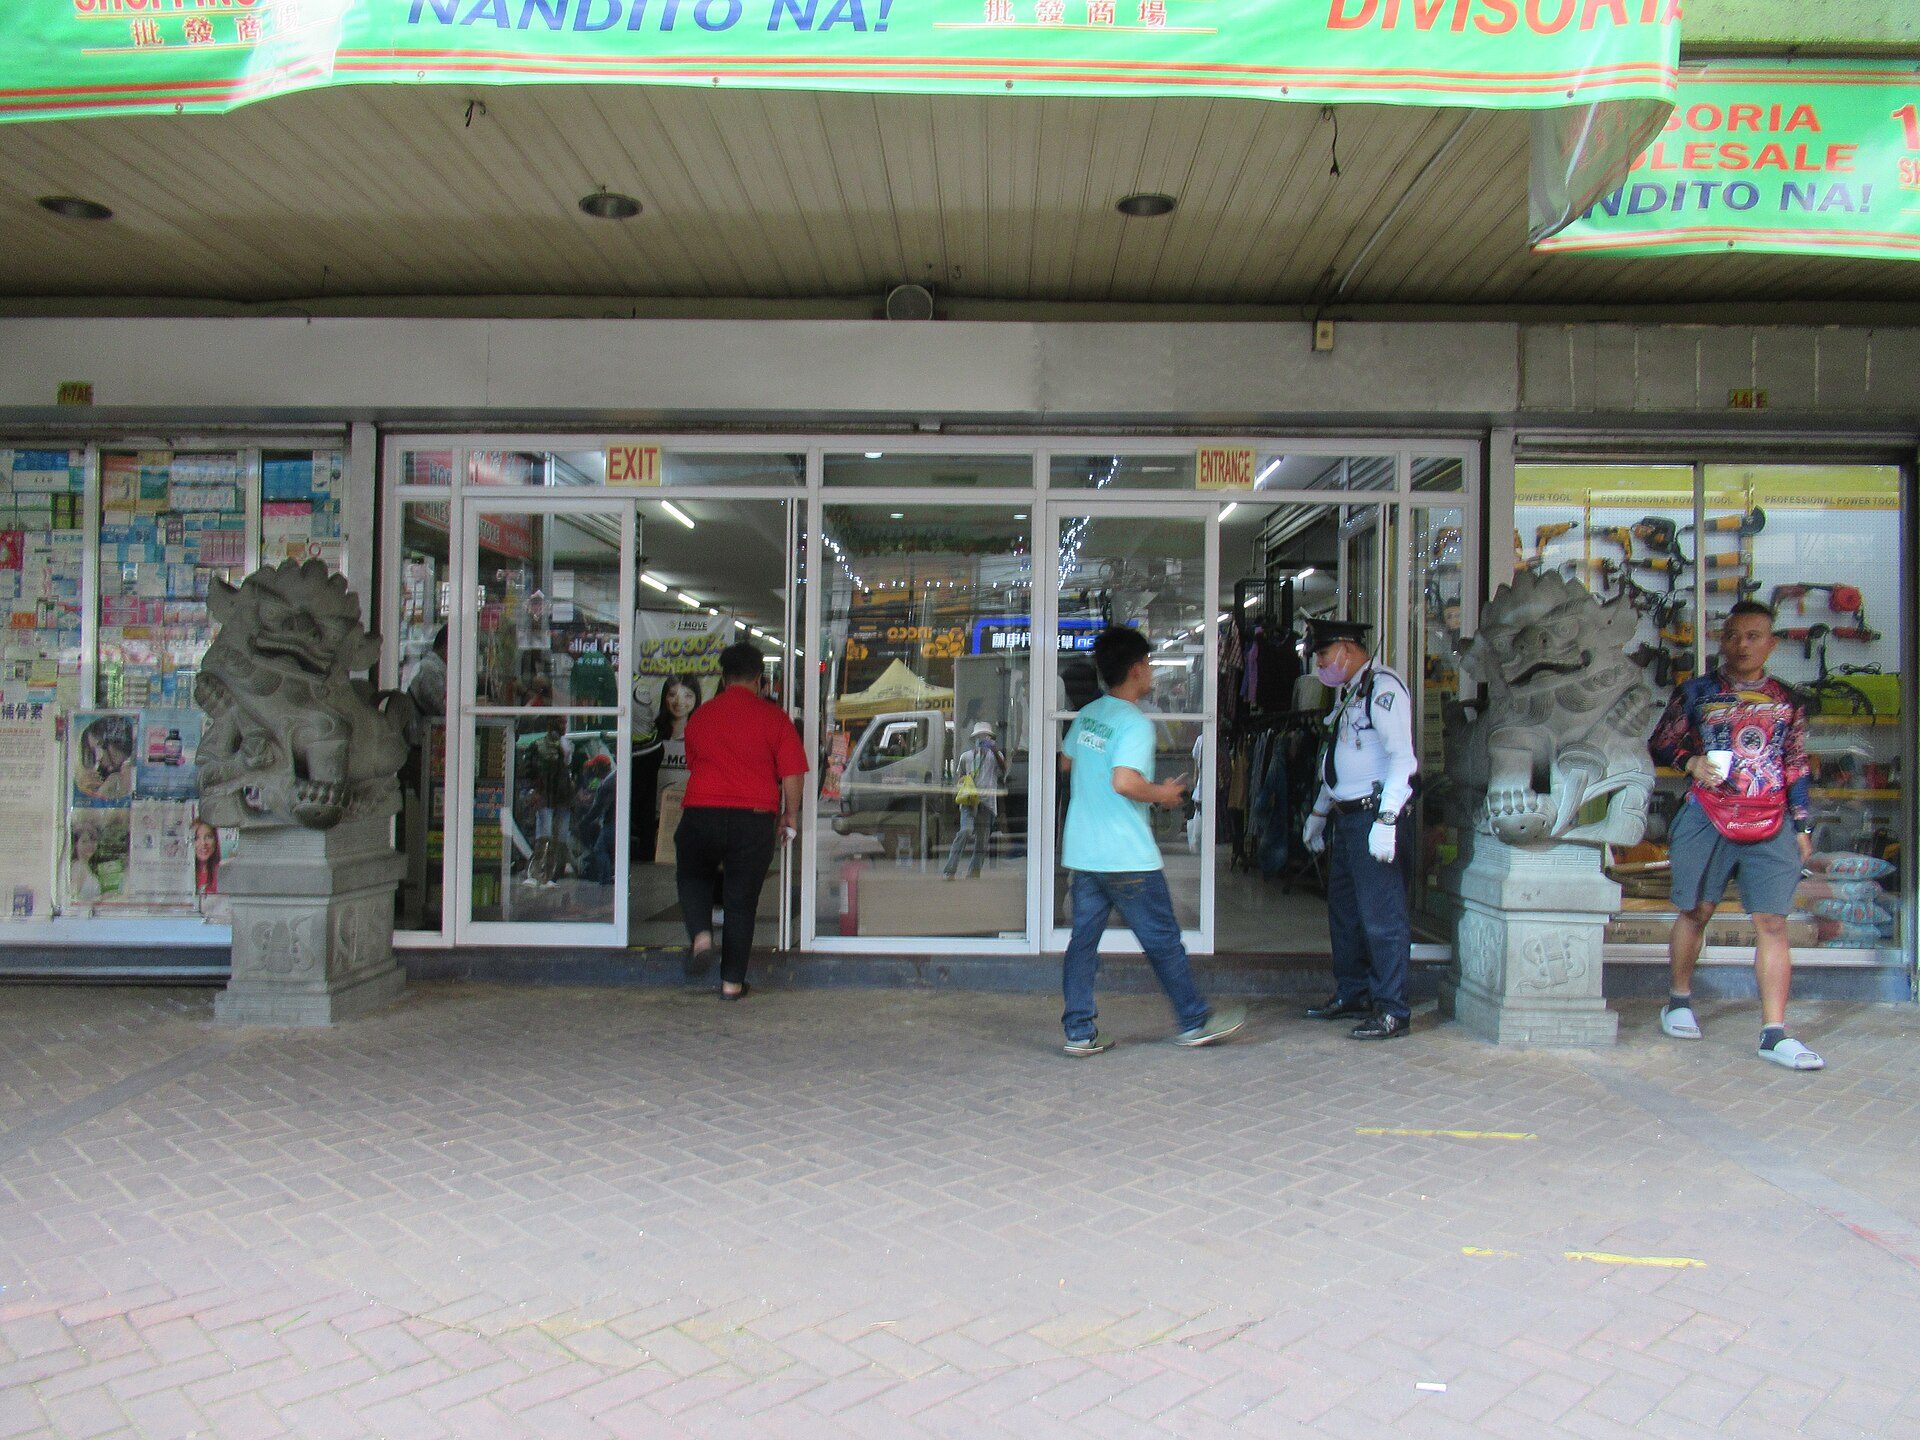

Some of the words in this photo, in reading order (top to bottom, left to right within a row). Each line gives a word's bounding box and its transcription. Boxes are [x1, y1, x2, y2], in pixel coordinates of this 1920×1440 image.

[1779, 183, 1873, 214] NA!
[608, 447, 658, 481] EXIT
[1200, 449, 1251, 483] ENTRANCE
